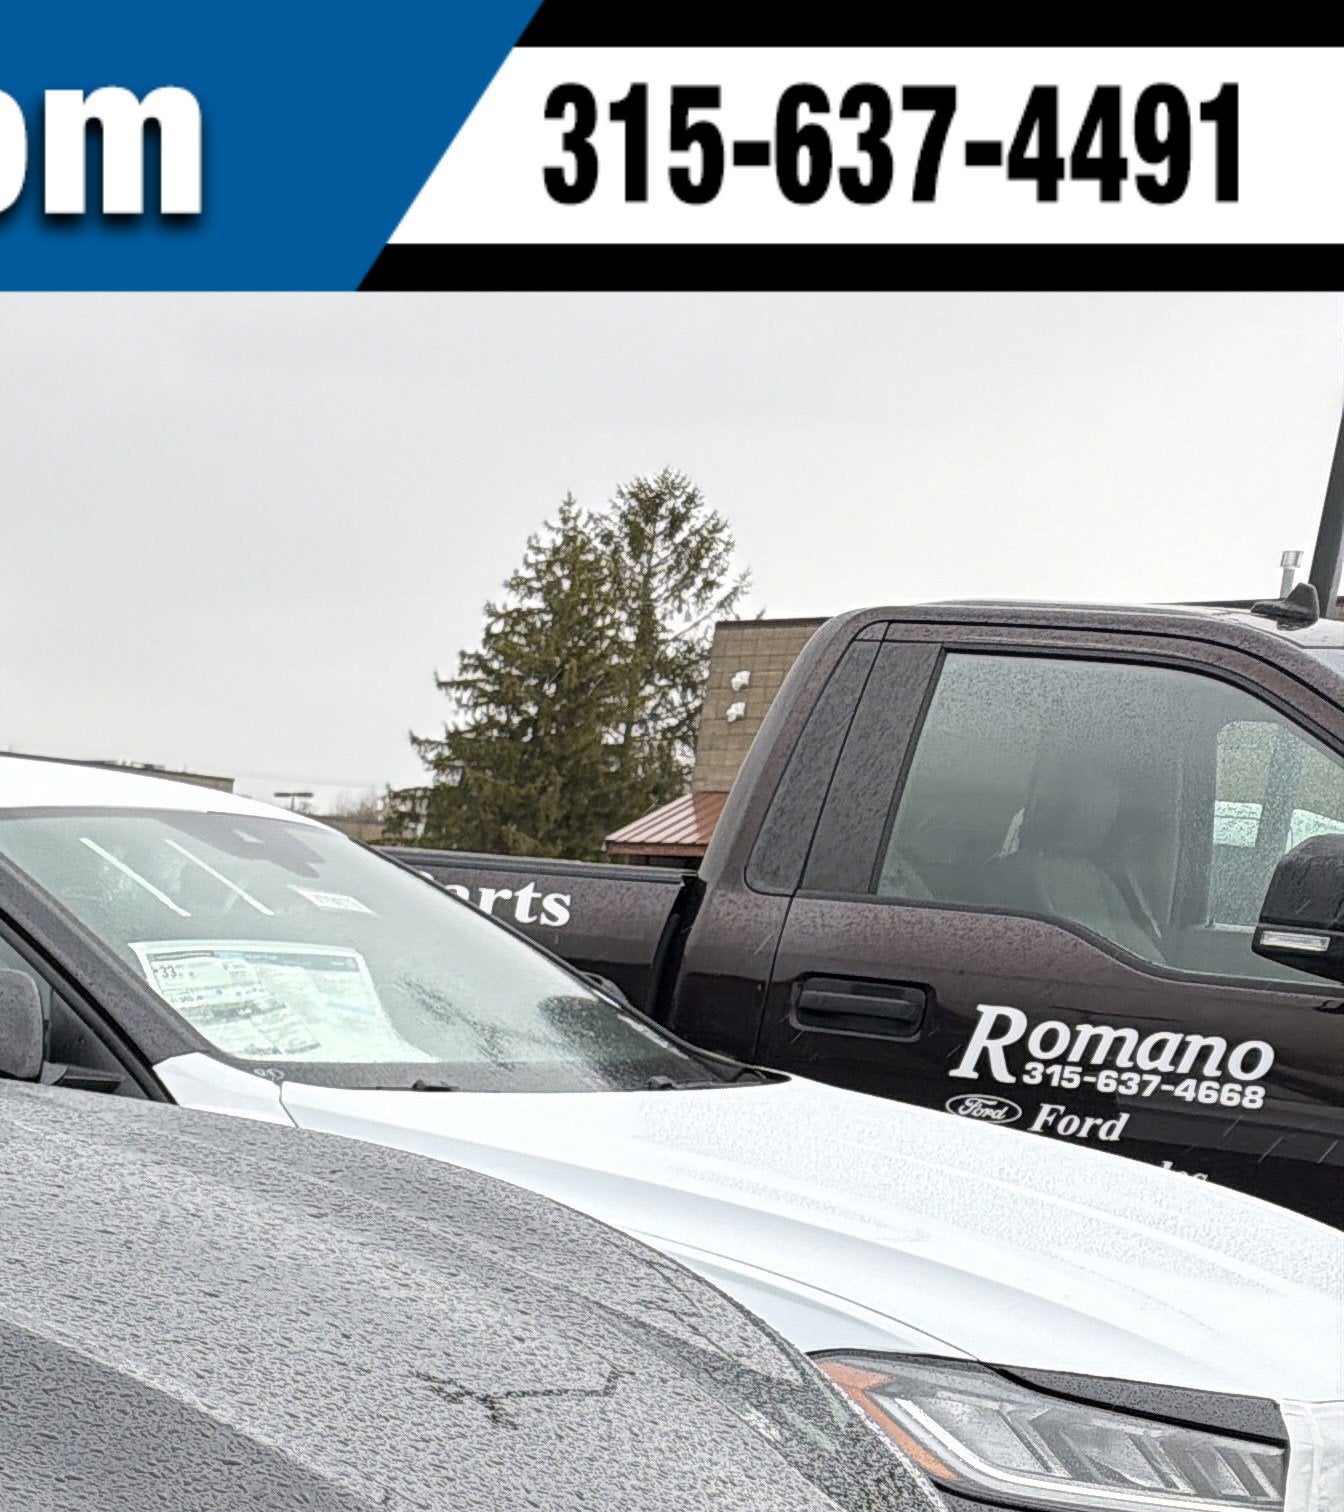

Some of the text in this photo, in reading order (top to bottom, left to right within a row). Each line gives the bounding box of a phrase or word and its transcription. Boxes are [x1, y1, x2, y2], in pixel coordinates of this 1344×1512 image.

[948, 1003, 1276, 1086] Romano
[1022, 1061, 1267, 1110] 315-637-4668
[955, 1096, 1012, 1121] Ford
[1028, 1103, 1132, 1142] Ford
